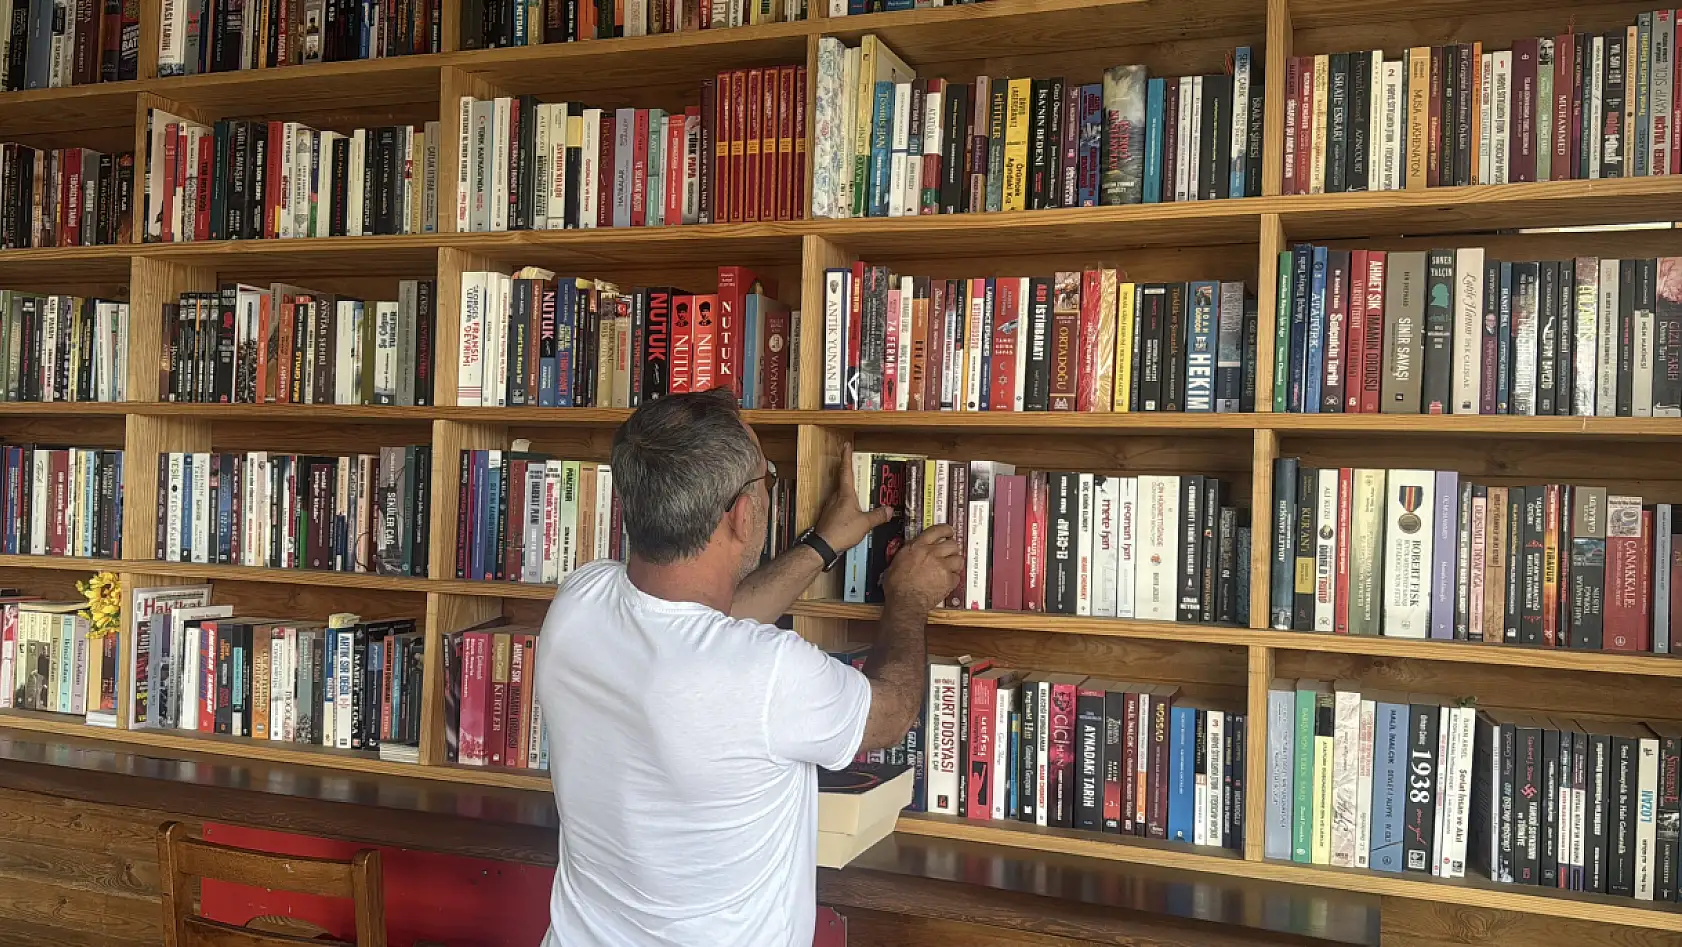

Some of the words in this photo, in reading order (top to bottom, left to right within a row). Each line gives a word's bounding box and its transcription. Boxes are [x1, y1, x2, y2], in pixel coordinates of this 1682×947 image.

[992, 93, 1005, 139] HİTİTLER
[1413, 89, 1423, 113] MUSA
[687, 131, 698, 155] TÜRK
[876, 127, 886, 148] HAN
[1557, 94, 1567, 156] MUHAMMED
[1035, 129, 1047, 166] BEDENİ
[1410, 122, 1422, 178] AKHENATON
[233, 151, 244, 192] SAVAŞLAR
[687, 156, 697, 179] PAPA
[1036, 283, 1048, 302] ABD
[1368, 260, 1383, 291] AHMET
[541, 291, 555, 340] NUTUK
[828, 300, 840, 335] ANTİK
[1367, 293, 1381, 310] ŞIK
[462, 325, 471, 367] DEVRİMİ
[471, 322, 480, 363] FRANSIZ
[648, 292, 668, 361] NUTUK
[720, 301, 732, 375] NUTUK
[1032, 304, 1048, 361] İSTİHBARATI
[1328, 312, 1343, 357] Selçuklu
[1397, 317, 1413, 345] SİNİR
[1659, 321, 1668, 341] Donna
[1667, 321, 1680, 347] GİZLİ
[673, 334, 689, 389] NUTUK
[696, 333, 712, 389] NUTUK
[827, 339, 838, 381] YUNAN
[886, 336, 896, 375] FERMAN
[1056, 326, 1069, 390] ORTADOĞU
[1326, 359, 1340, 386] Tarihi
[1364, 352, 1378, 392] ORDUSU
[1392, 347, 1411, 381] SAVAŞI
[1667, 352, 1680, 381] TARİH
[1187, 354, 1212, 410] HEKİM
[1056, 518, 1070, 560] EL-CEVAP
[1411, 539, 1422, 579] ROBERT
[1409, 583, 1420, 607] FISK
[511, 643, 522, 668] AHMET
[1155, 703, 1165, 742] MOSSAD
[1388, 709, 1397, 733] HALİL
[941, 721, 955, 773] DOSYASI
[1083, 724, 1096, 776] AYNADAKİ
[1387, 733, 1398, 764] İNALCIK
[1082, 777, 1095, 807] TARİH
[1409, 747, 1432, 804] 1938
[1456, 769, 1468, 792] Şeriat
[1640, 790, 1654, 824] LOZAN
